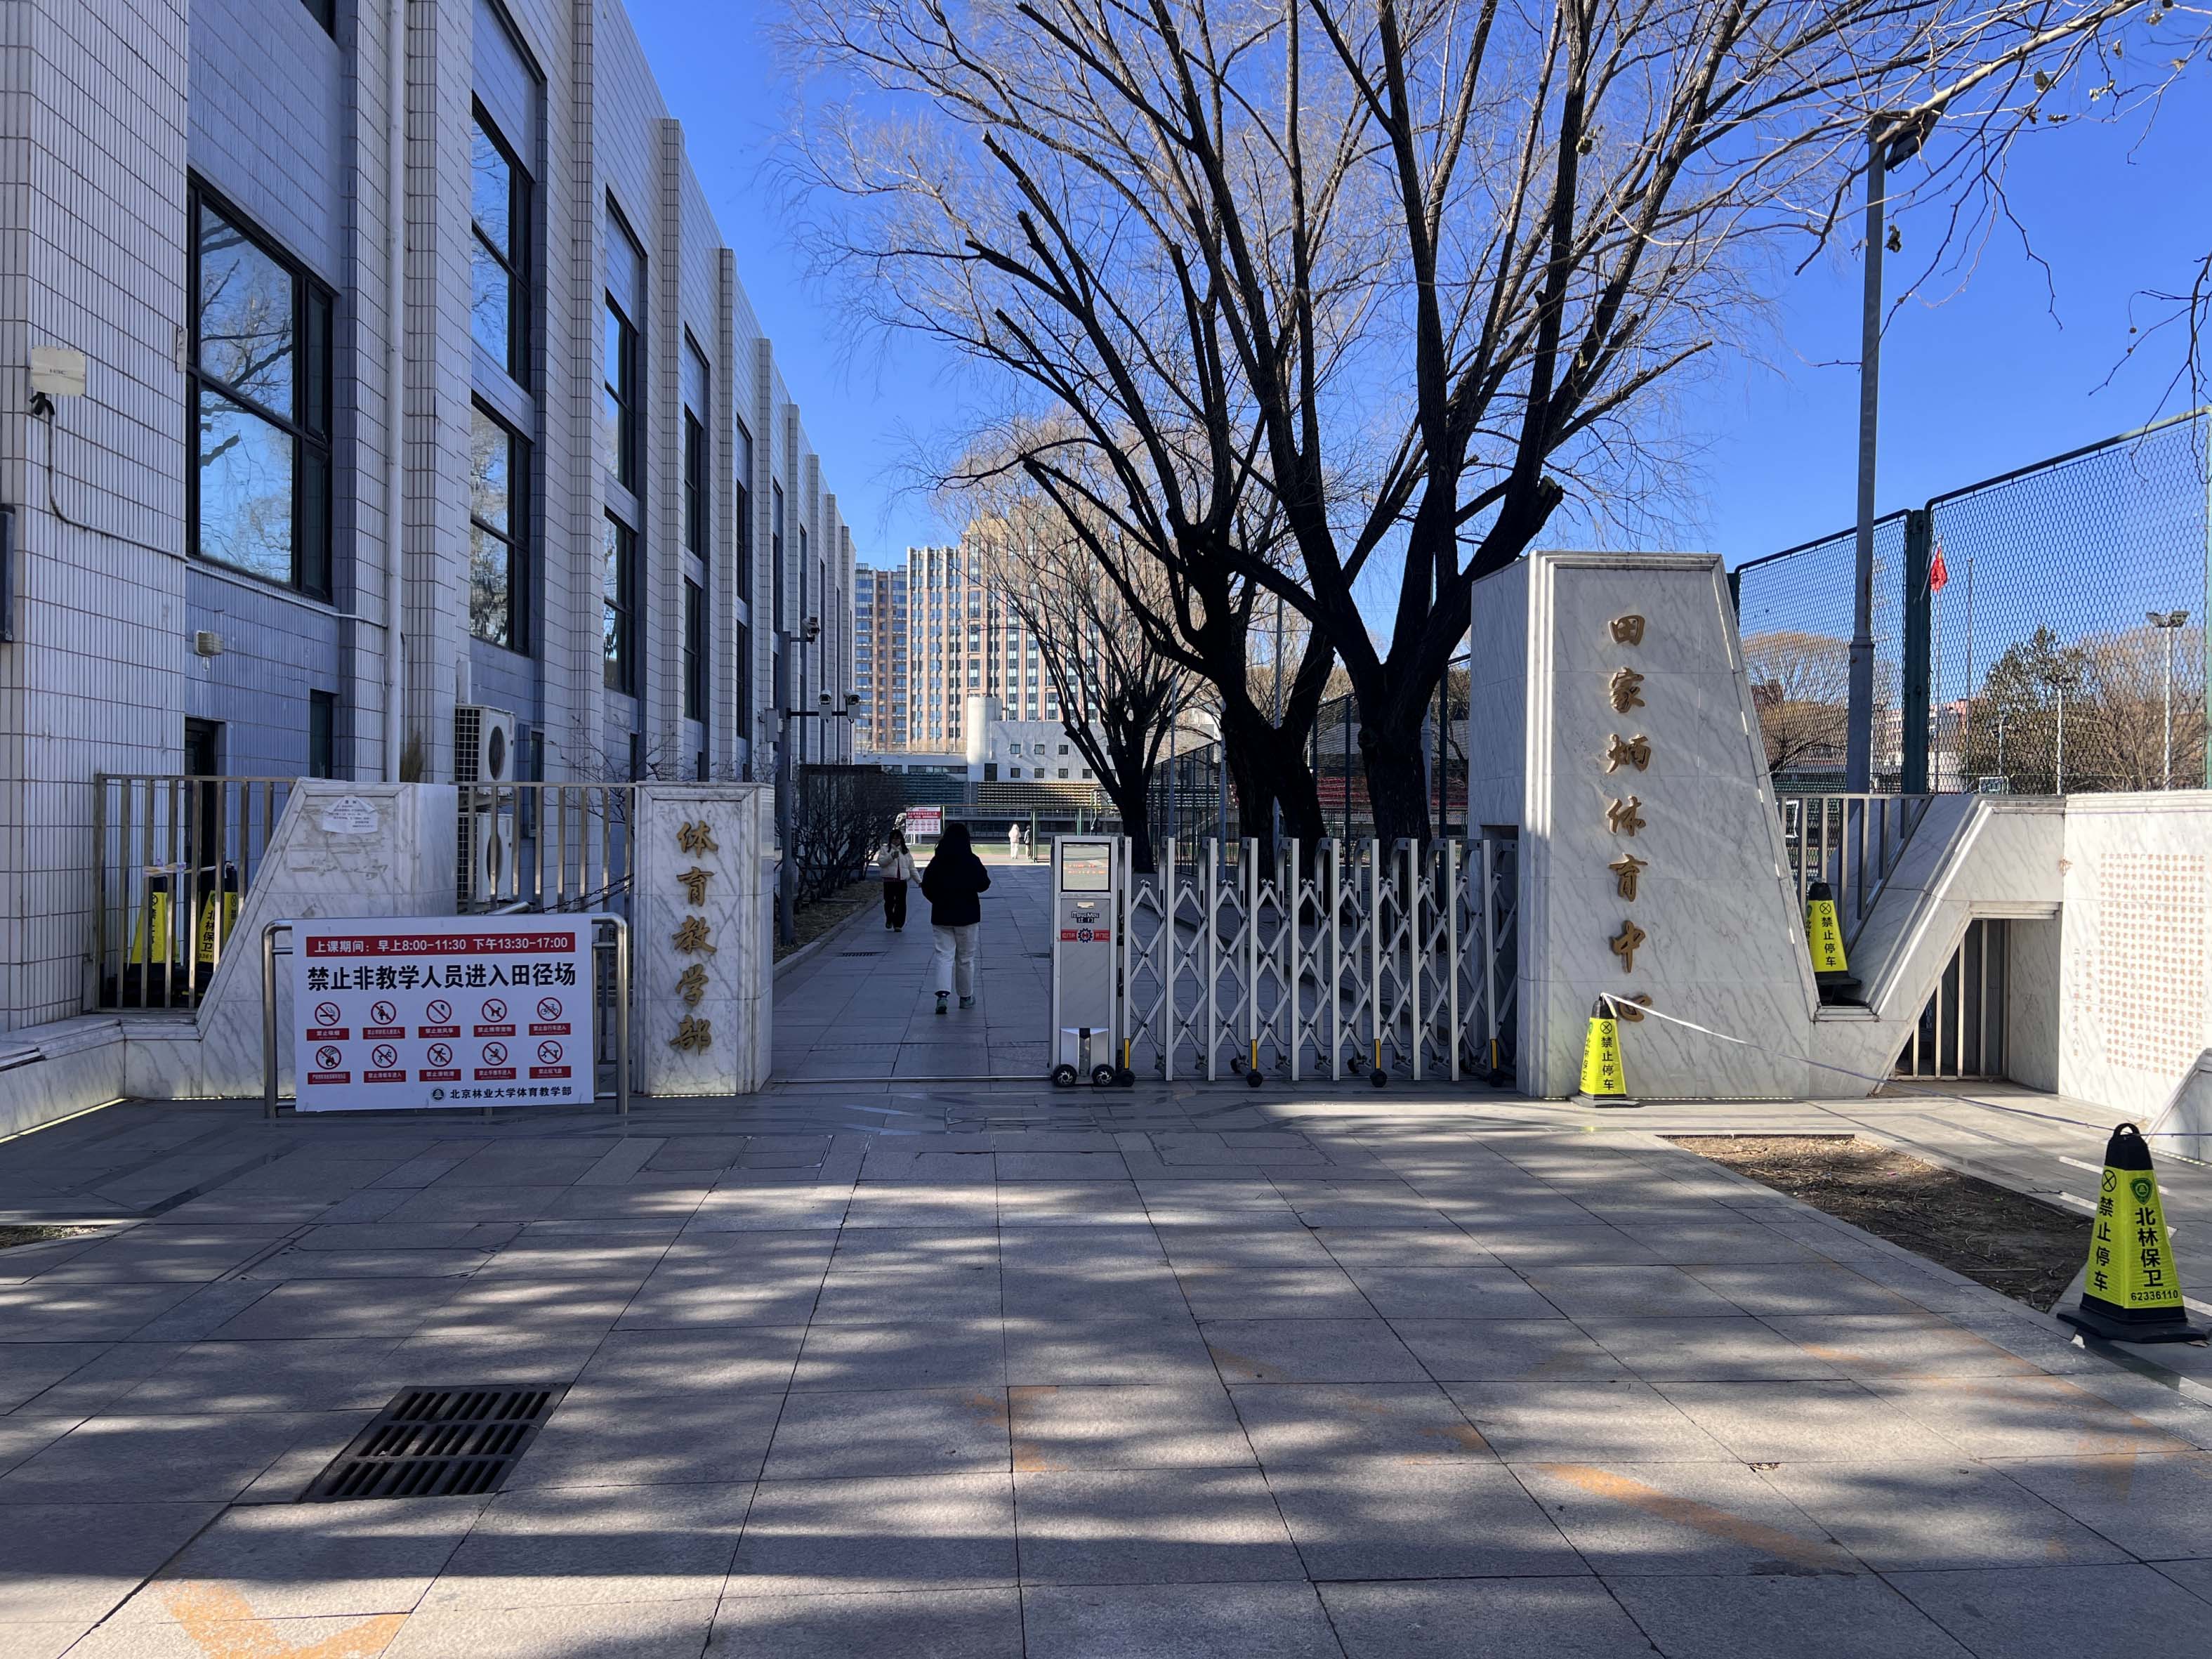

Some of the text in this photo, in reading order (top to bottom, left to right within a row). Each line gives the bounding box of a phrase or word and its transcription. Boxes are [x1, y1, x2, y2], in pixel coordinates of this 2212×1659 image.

[1606, 615, 1652, 1023] 田家炳体育中心
[669, 820, 718, 1056] 体育教学部
[1821, 917, 1837, 967] 禁止停车
[308, 962, 576, 991] 禁止非教学人员进入田径场
[1600, 1036, 1614, 1091] 禁止停车
[449, 1087, 572, 1099] 北京林业大学体育教学部
[2093, 1196, 2114, 1291] 禁止停车
[2135, 1207, 2163, 1287] 北林保卫
[2131, 1290, 2178, 1301] 62336110
